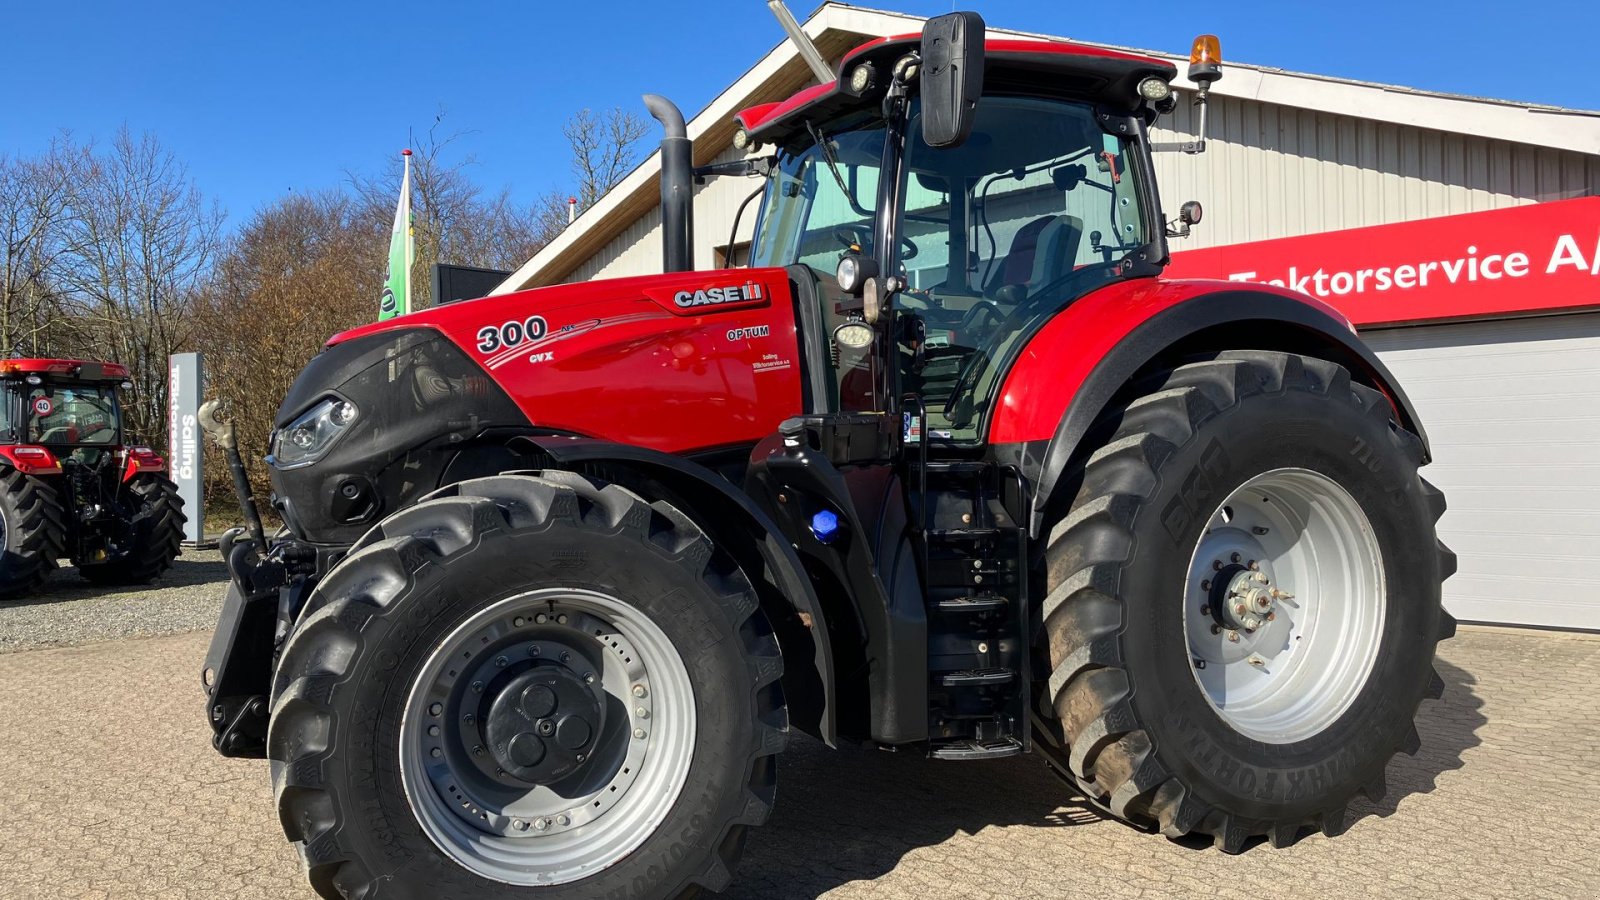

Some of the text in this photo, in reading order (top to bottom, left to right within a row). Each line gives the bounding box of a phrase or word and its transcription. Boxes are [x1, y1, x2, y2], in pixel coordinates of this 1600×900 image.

[1228, 245, 1530, 297] Tktorservice
[674, 286, 741, 308] CASE
[476, 315, 548, 354] 300
[726, 324, 770, 342] OPTUM
[529, 351, 554, 363] CVX
[37, 402, 49, 411] 40
[180, 414, 195, 480] Salling
